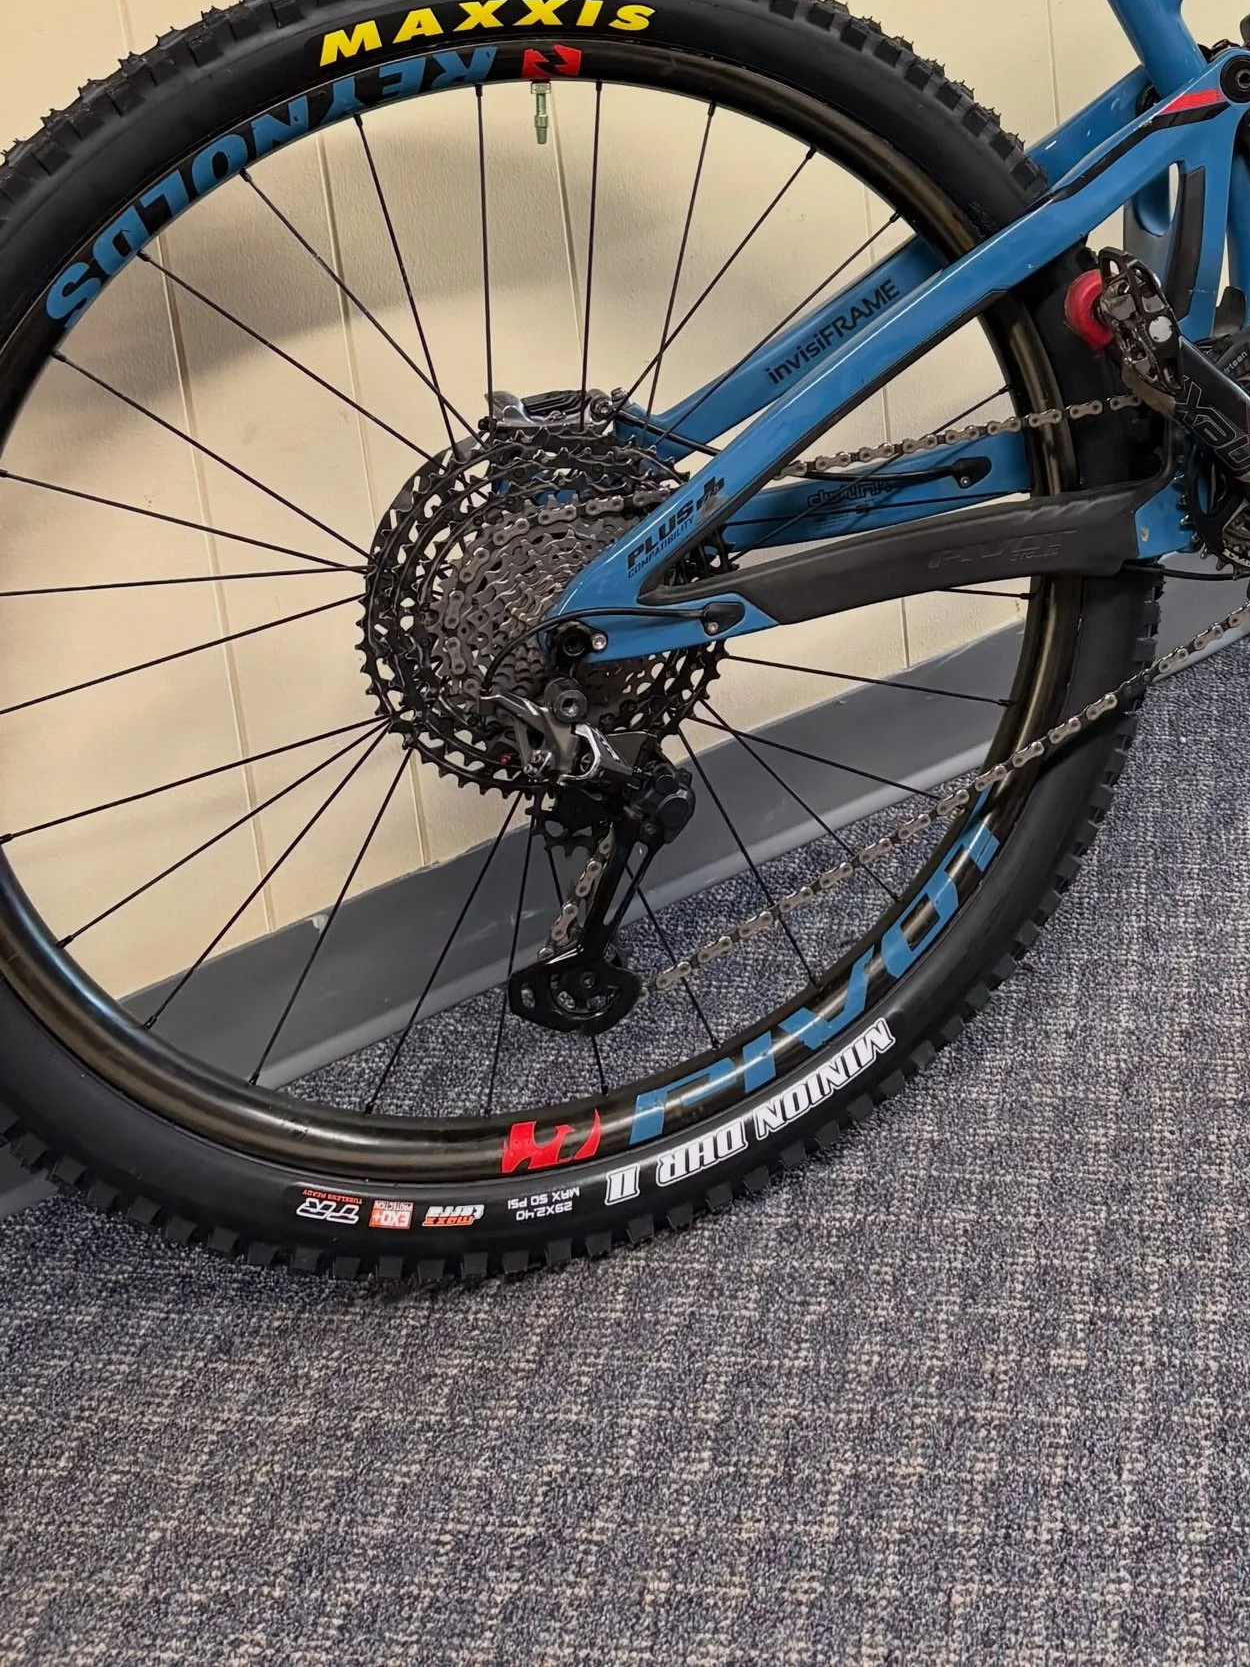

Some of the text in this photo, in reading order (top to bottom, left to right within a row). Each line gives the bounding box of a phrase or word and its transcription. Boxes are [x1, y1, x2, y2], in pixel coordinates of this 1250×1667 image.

[45, 45, 499, 332] REYNOLDS
[764, 277, 902, 387] invisiFRAME
[627, 498, 694, 571] PLUS
[627, 515, 696, 580] COMPATIBILITY
[628, 783, 1001, 1145] PIVOT
[752, 1016, 897, 1138] MINION
[655, 1128, 750, 1188] DHR
[296, 1197, 361, 1225] TR
[370, 1209, 411, 1228] EXO+
[373, 1200, 414, 1212] PROTECTION
[507, 1186, 581, 1210] MAX 50 PSI
[515, 1200, 574, 1221] 29X2.40
